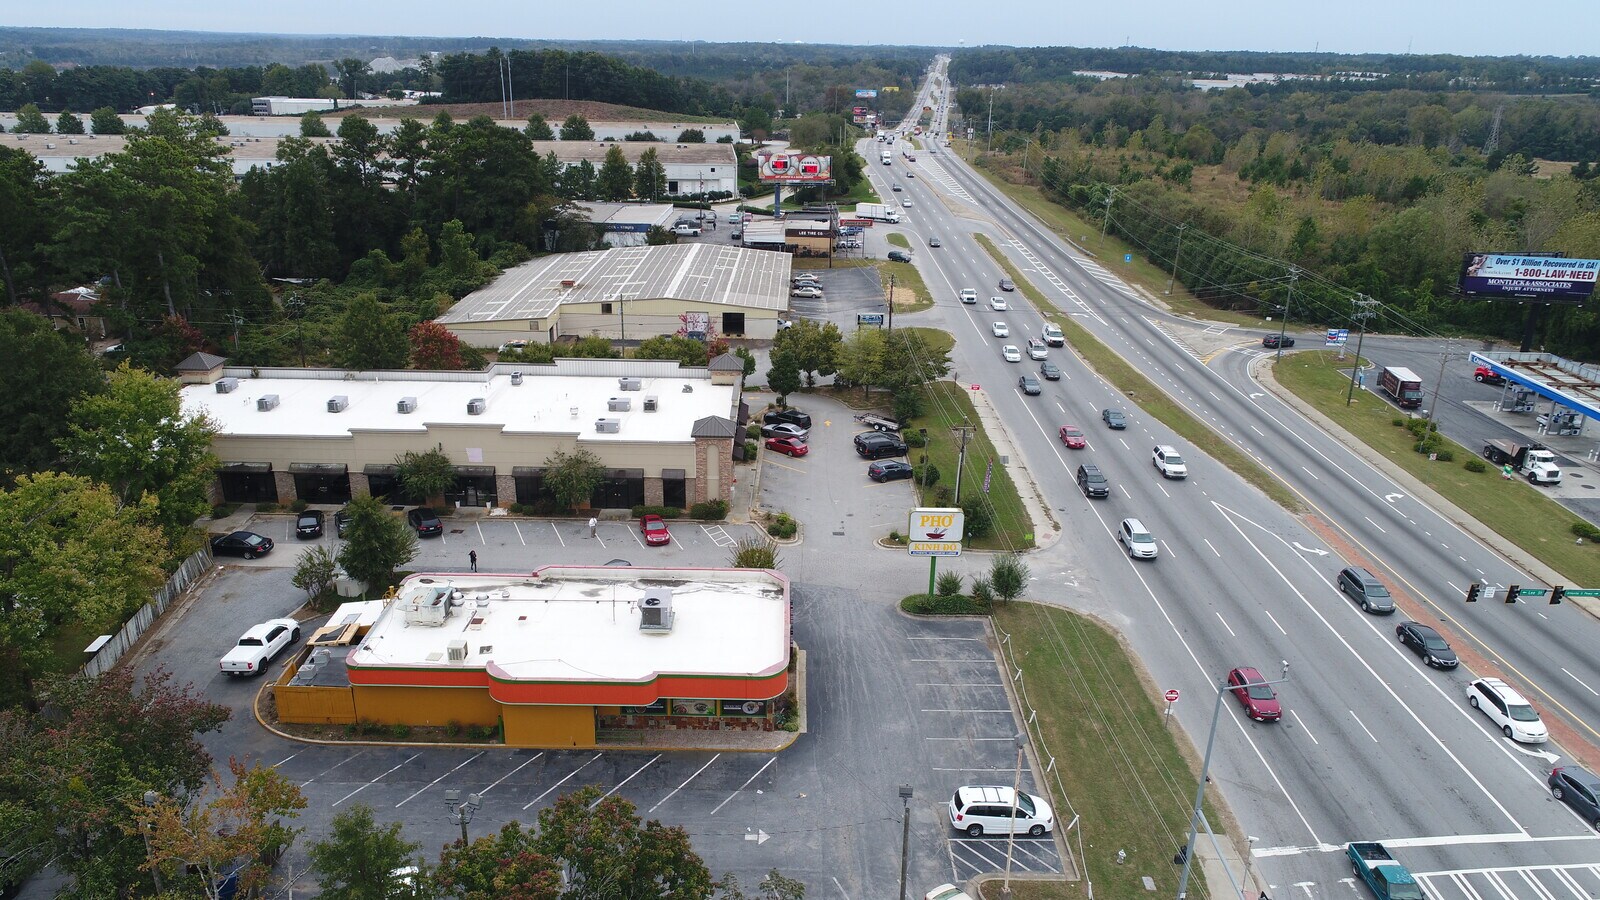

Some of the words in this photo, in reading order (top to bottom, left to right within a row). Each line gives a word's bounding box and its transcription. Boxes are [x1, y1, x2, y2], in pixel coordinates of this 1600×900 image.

[1495, 257, 1511, 266] Over
[1511, 258, 1521, 267] $1
[1521, 258, 1541, 267] Billion
[1542, 259, 1578, 269] Recovered
[1578, 261, 1586, 269] in
[1585, 261, 1598, 270] GA!
[1514, 267, 1595, 280] 1-800-LAW-NEED
[914, 543, 940, 551] KINH
